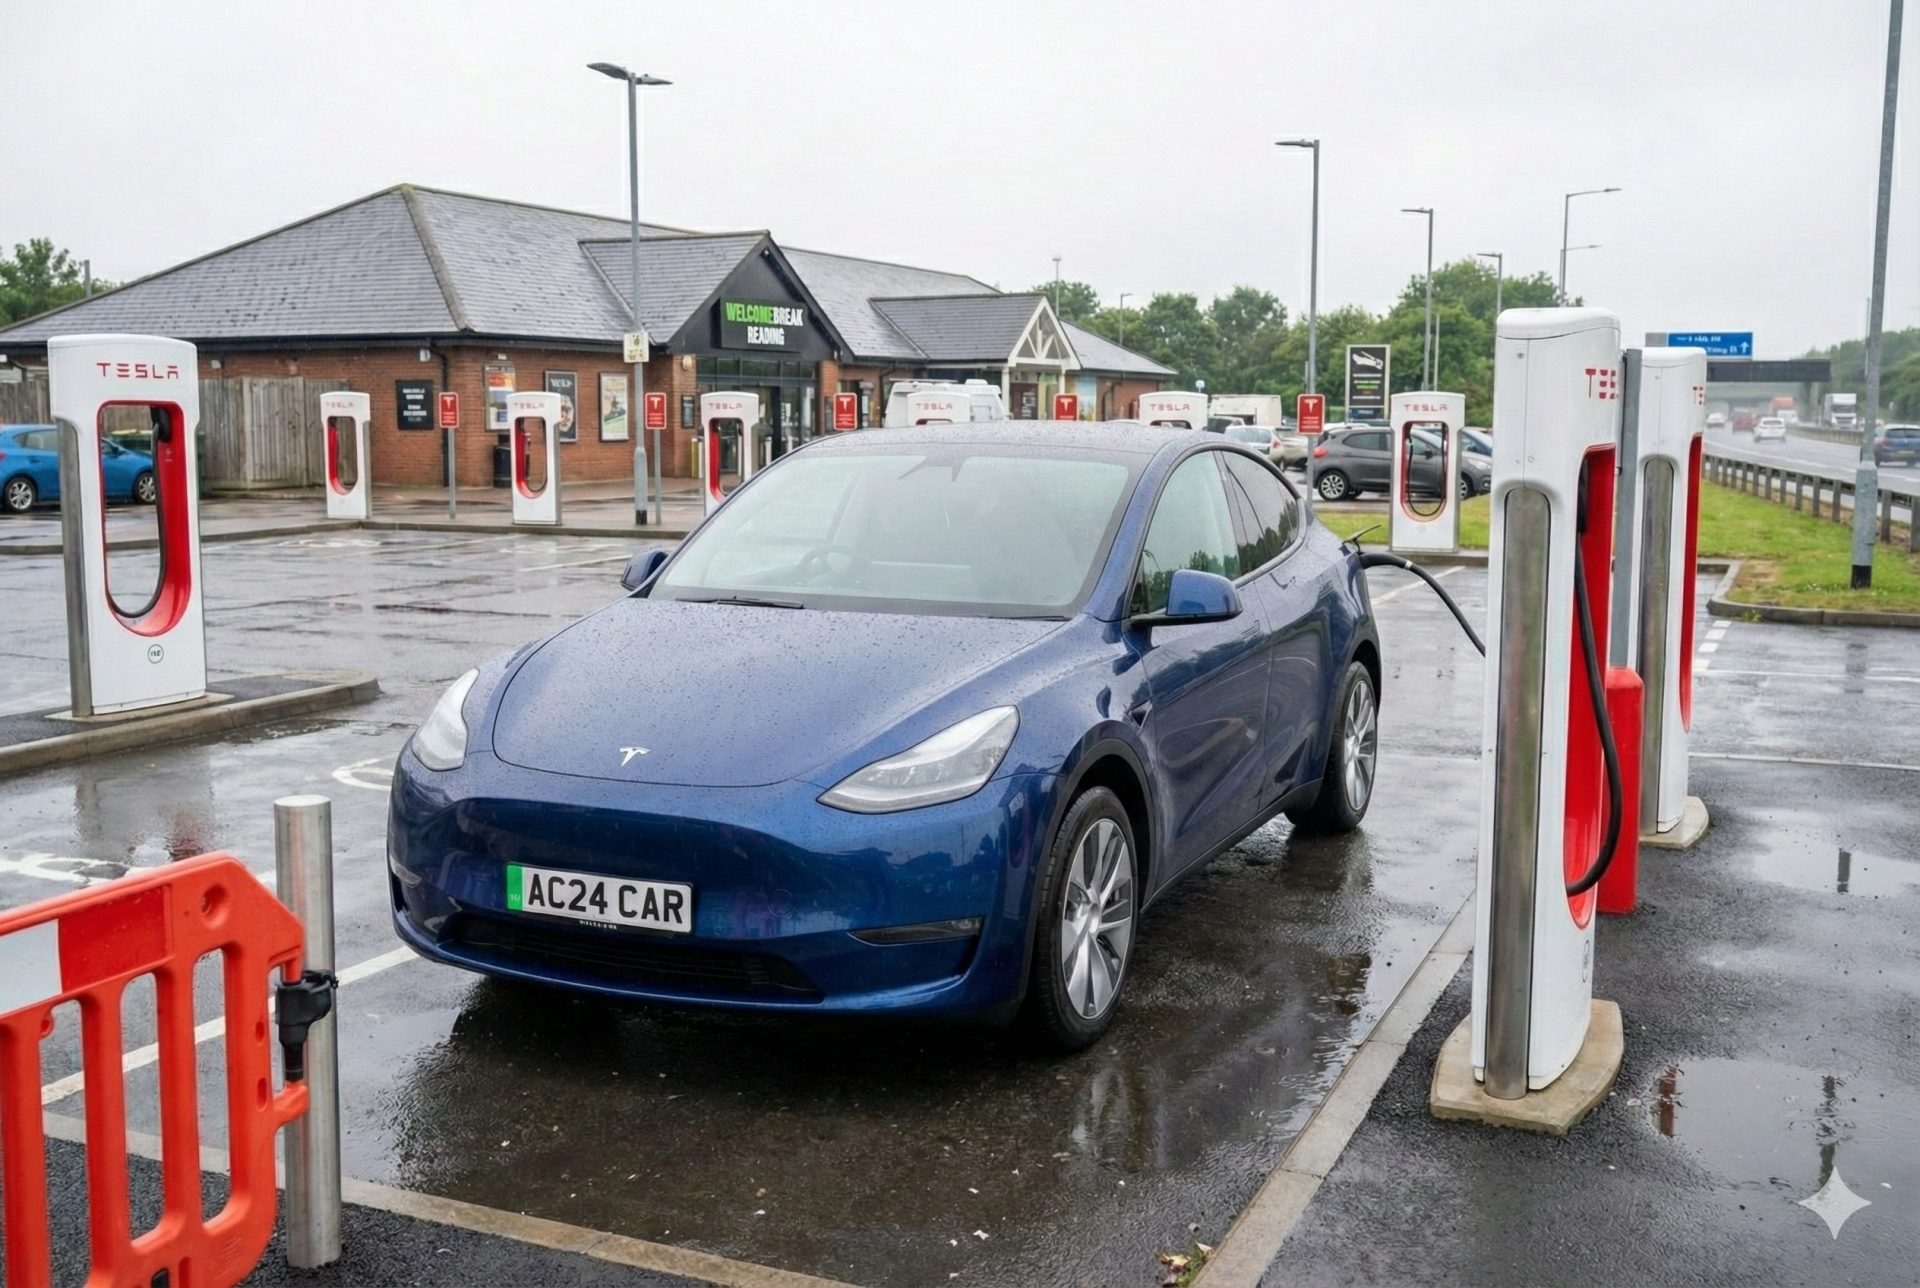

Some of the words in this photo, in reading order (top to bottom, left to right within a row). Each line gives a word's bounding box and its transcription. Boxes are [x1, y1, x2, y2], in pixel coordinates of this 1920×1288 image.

[747, 326, 785, 345] READING
[96, 362, 179, 379] TESLA
[708, 402, 743, 410] TESLA
[916, 402, 953, 410] TESLA
[1150, 403, 1191, 411] TESLA
[1403, 403, 1448, 412] TESLA
[527, 873, 609, 915] AC24
[618, 884, 684, 924] CAR
